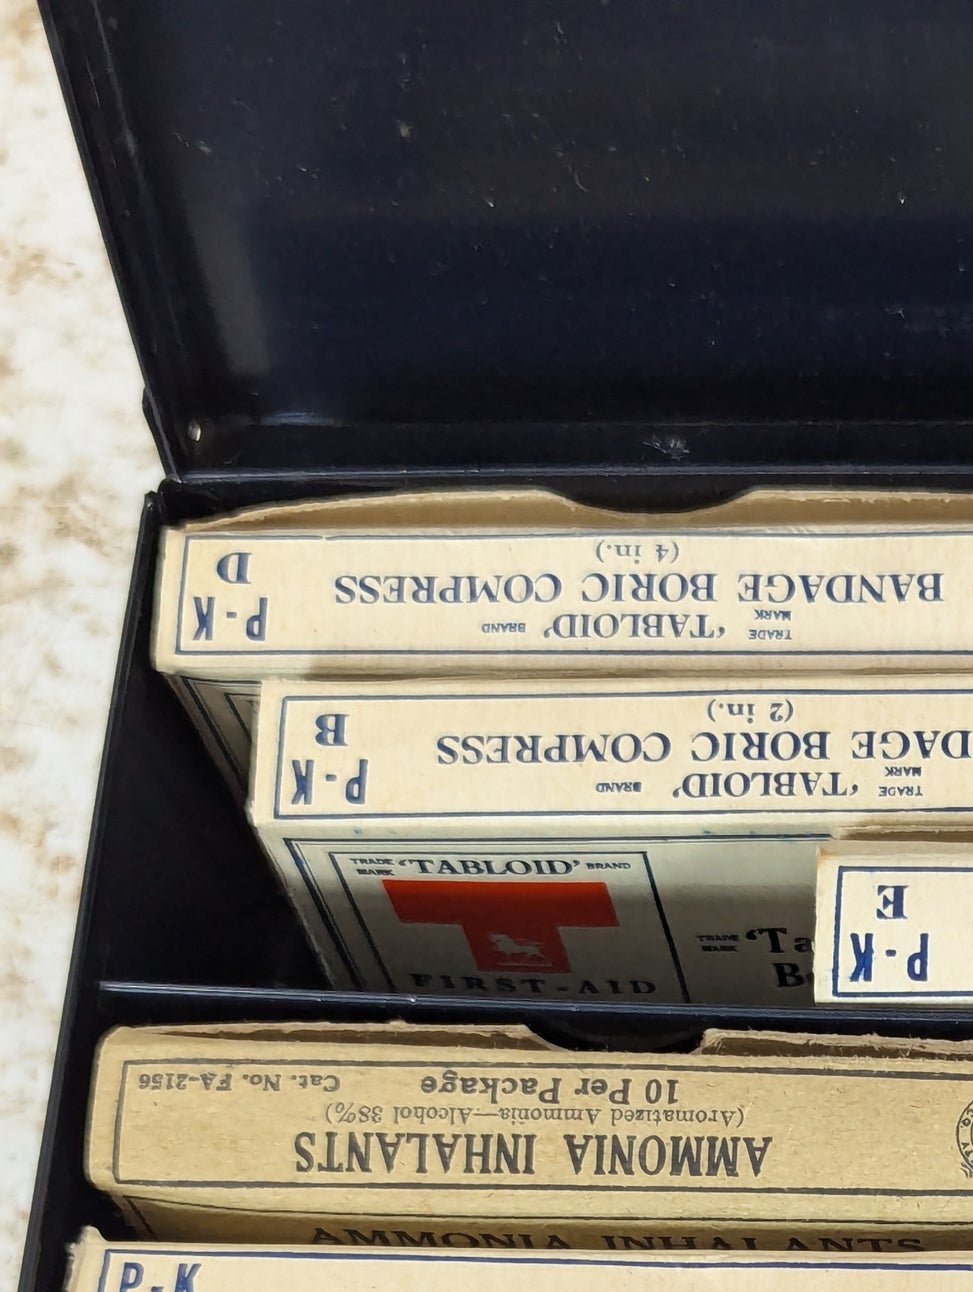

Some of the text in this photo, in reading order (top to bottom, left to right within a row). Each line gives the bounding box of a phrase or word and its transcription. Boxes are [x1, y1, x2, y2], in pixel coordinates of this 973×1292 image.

[595, 540, 680, 564] (4 in.)
[216, 551, 253, 585] D
[334, 572, 945, 605] BANDAGE BORIC COMPRESS
[754, 610, 791, 621] MARK
[481, 621, 527, 635] BRAND
[748, 628, 792, 640] TRADE
[706, 699, 795, 723] (2 in.)
[314, 713, 350, 748] B
[436, 733, 671, 765] COMPRESS
[691, 731, 831, 762] BORIC
[884, 766, 922, 777] MARK
[595, 781, 641, 793] BRAND
[878, 785, 924, 797] TRADE
[876, 884, 909, 921] E
[138, 1072, 340, 1092] Cat. No. FA-2156
[420, 1070, 679, 1104] 10 Per Package
[326, 1102, 386, 1124] 38%)
[612, 1106, 745, 1128] (Aromatized
[294, 1131, 774, 1178] AMMONIA INHALANTS
